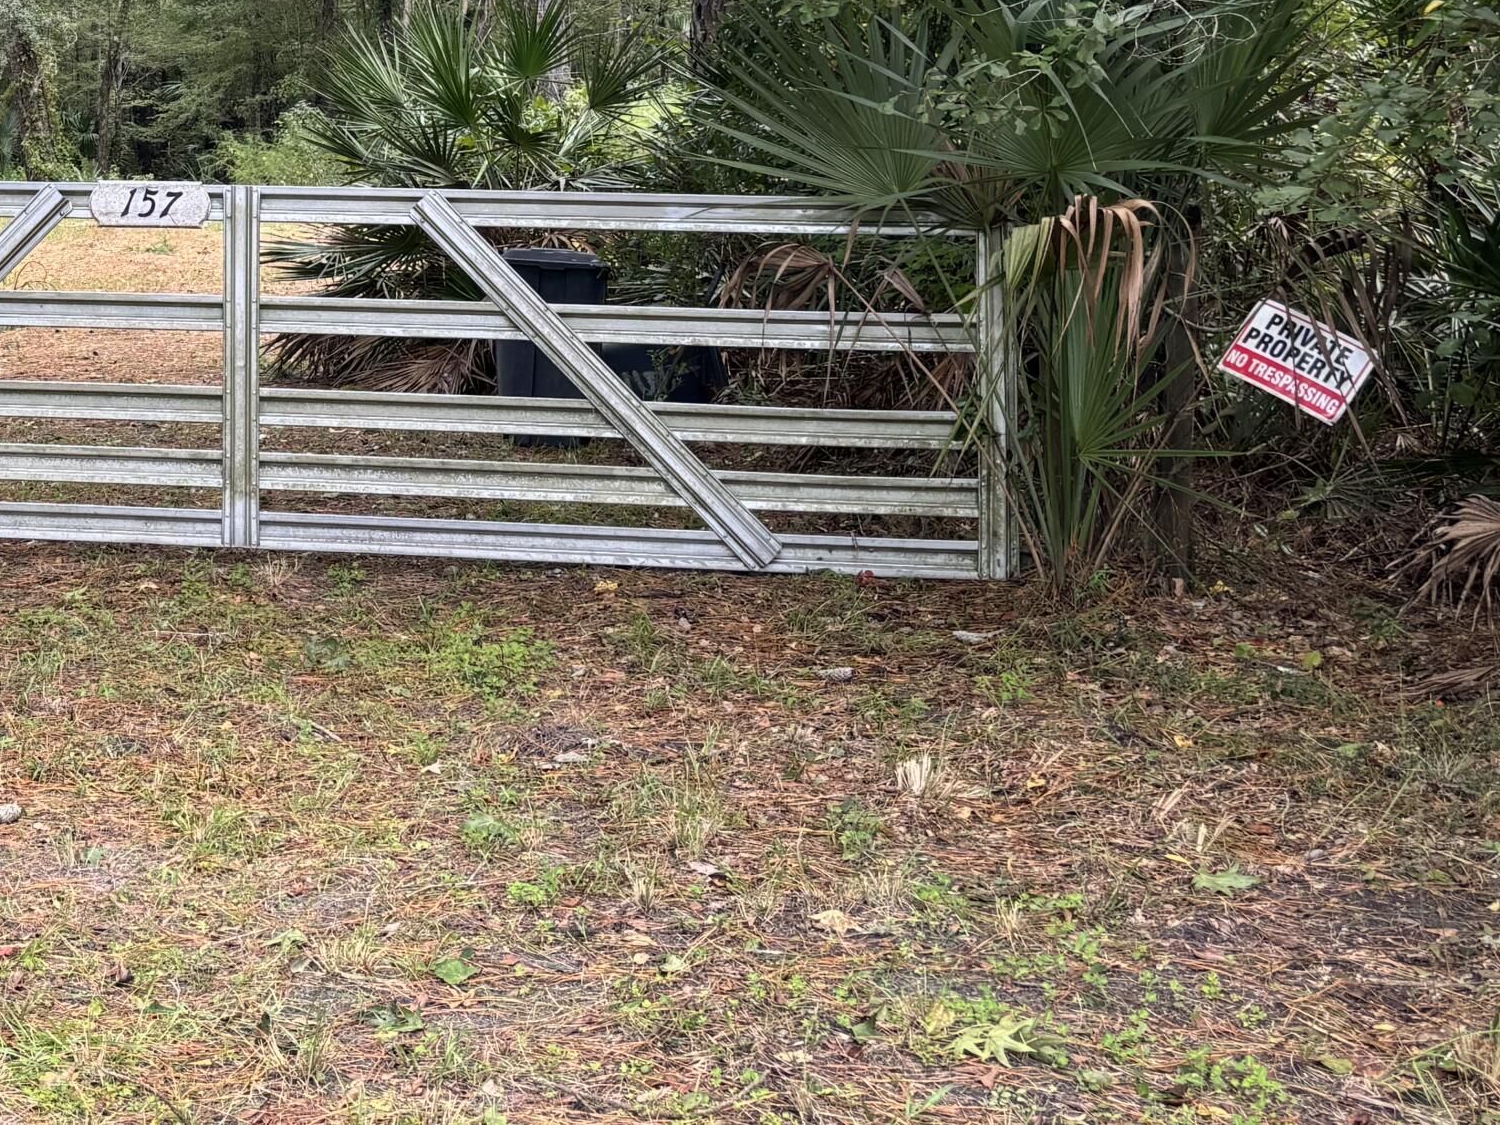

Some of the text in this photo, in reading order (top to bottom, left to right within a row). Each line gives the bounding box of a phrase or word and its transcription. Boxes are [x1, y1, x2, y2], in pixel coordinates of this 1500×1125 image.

[120, 187, 183, 218] 157
[1226, 349, 1340, 415] NO TRESPASSING
